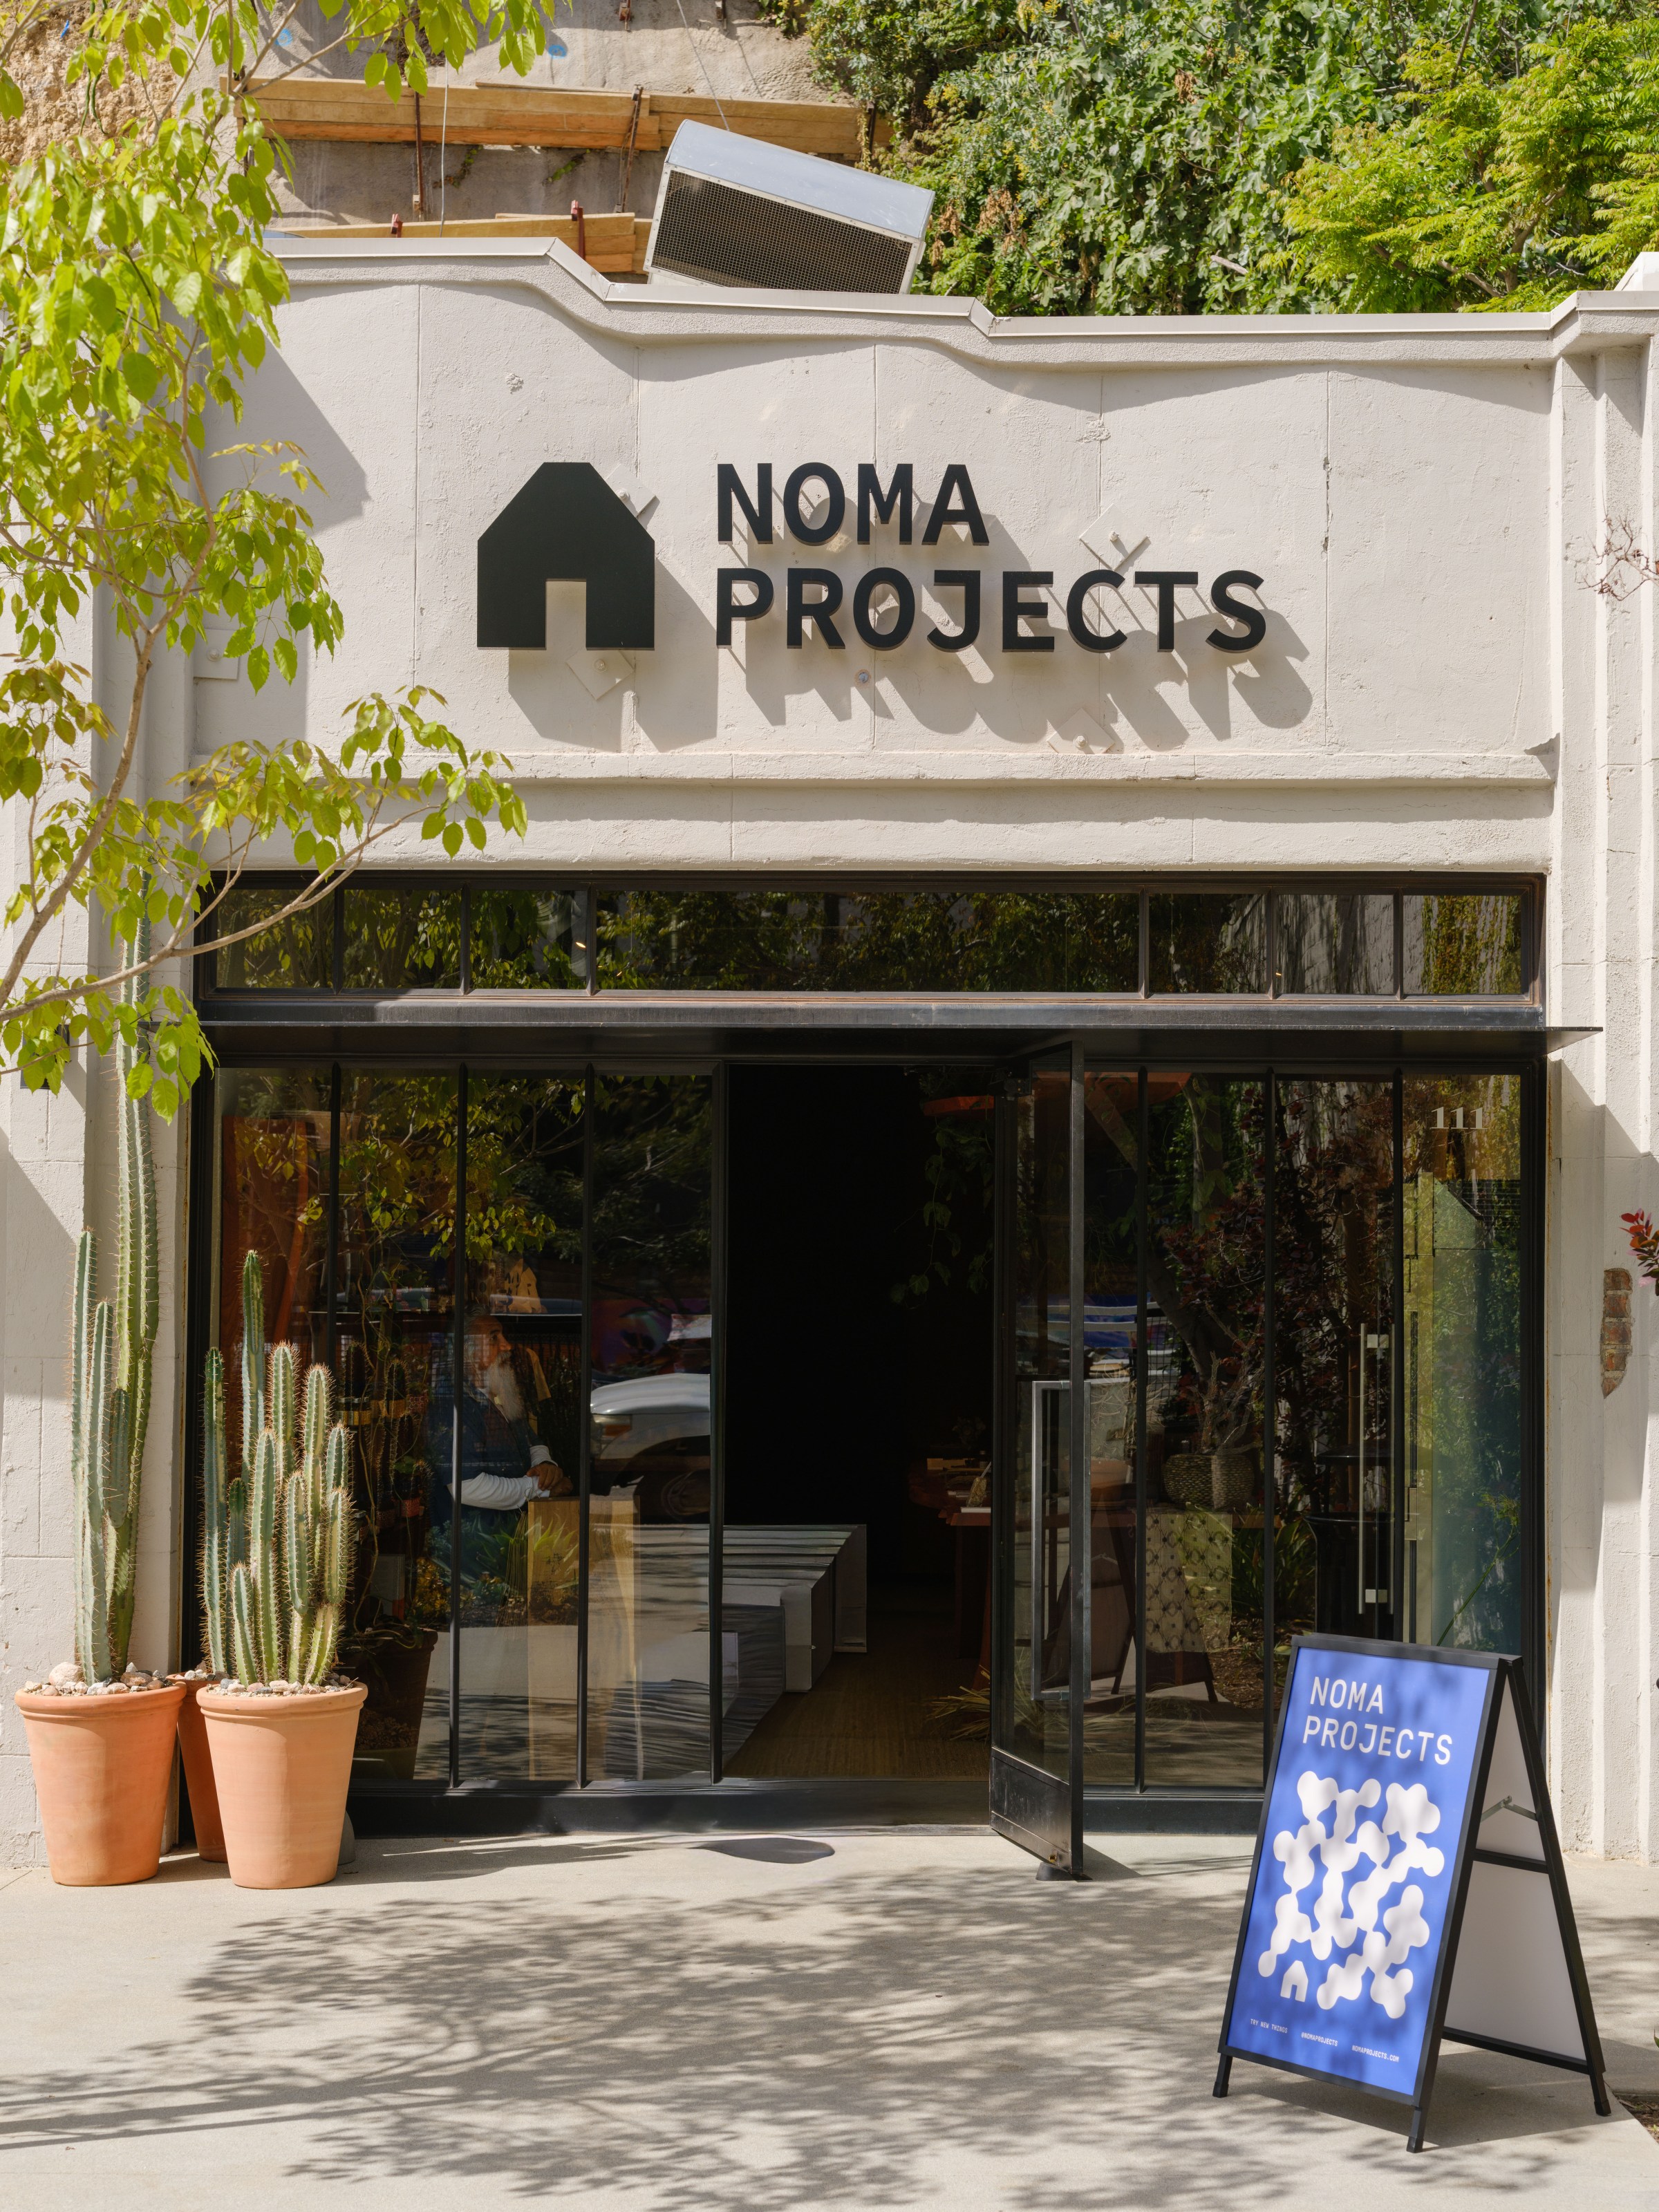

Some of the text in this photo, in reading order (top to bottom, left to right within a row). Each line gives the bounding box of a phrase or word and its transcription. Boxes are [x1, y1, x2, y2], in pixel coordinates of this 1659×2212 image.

[718, 462, 989, 546] NOMA
[716, 567, 1266, 653] PROJECTS
[1431, 1106, 1488, 1130] 111
[1310, 1676, 1383, 1714] NOMA
[1302, 1715, 1453, 1765] PROJECTS
[1271, 2024, 1288, 2034] THINGS
[1301, 2032, 1338, 2047] @NOMAPROJECTS
[1351, 2045, 1400, 2063] NOMAPROJECTS.COM
